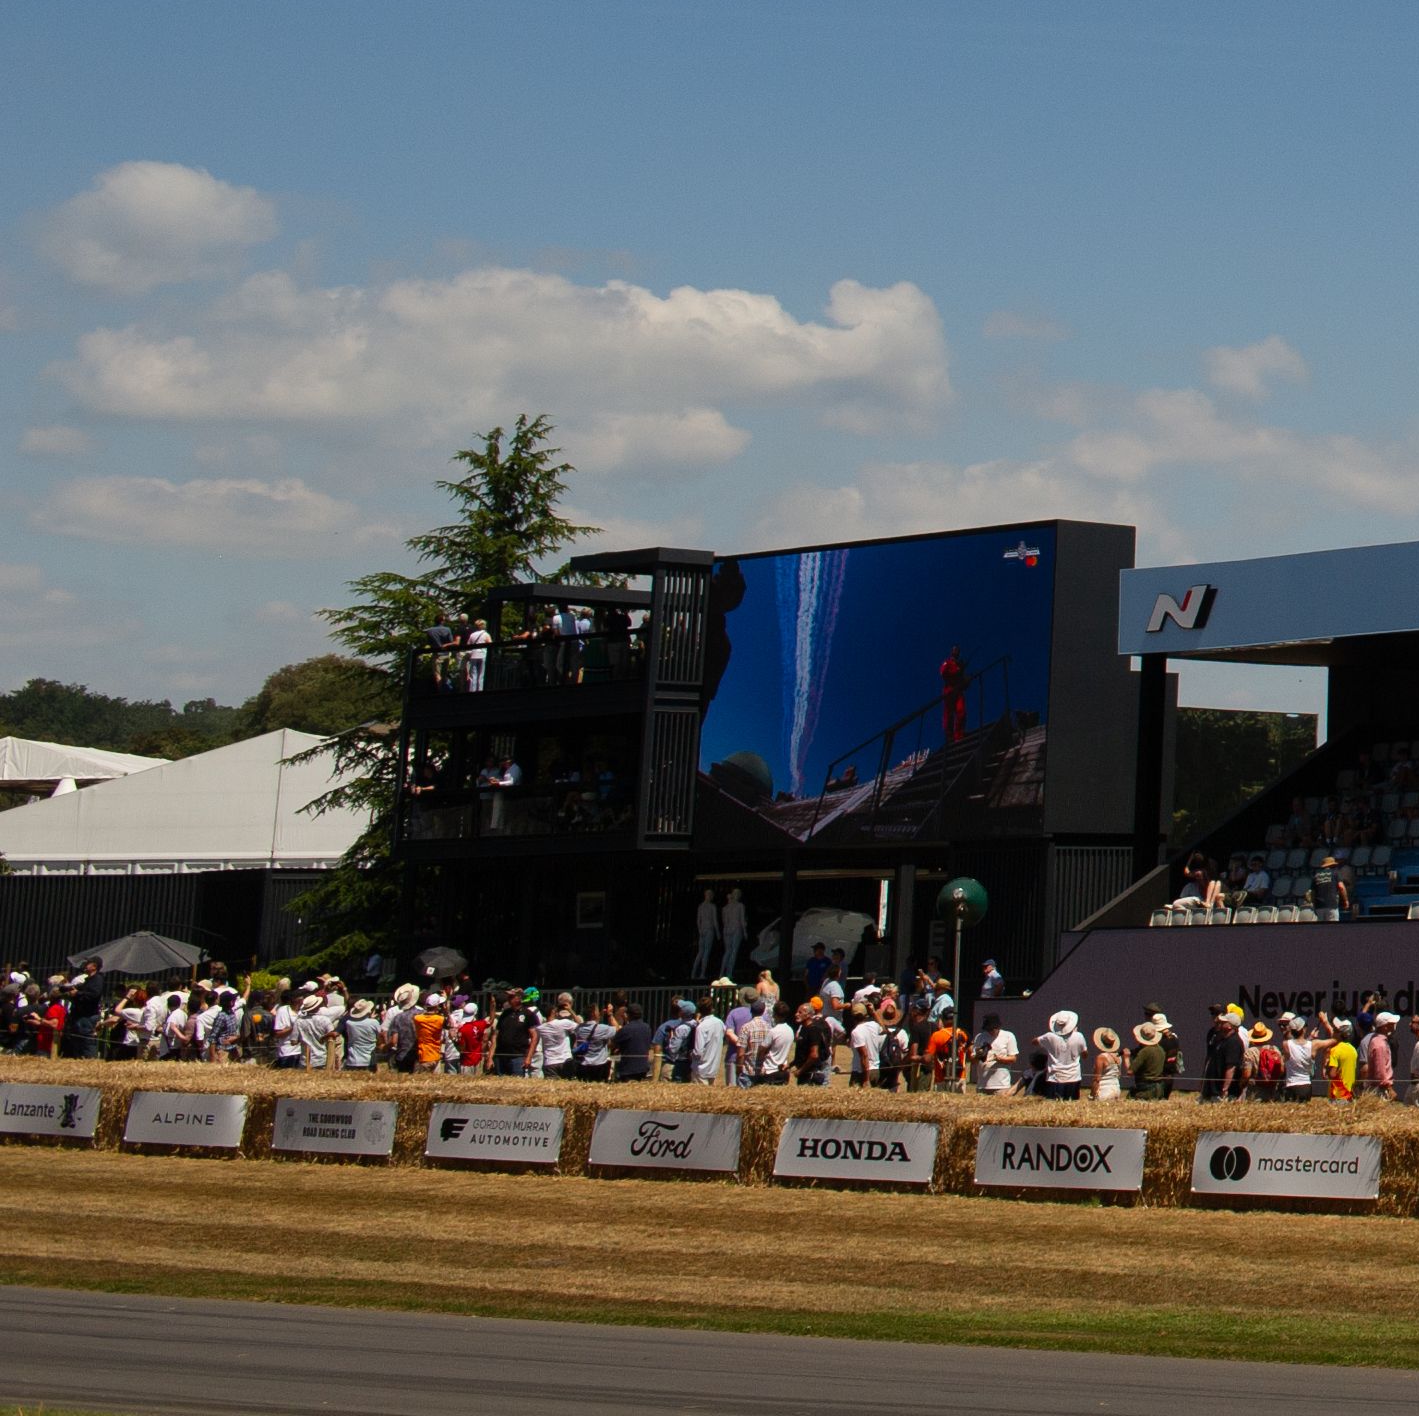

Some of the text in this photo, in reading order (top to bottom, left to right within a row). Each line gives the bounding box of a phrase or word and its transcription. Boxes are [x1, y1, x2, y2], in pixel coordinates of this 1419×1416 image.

[1145, 583, 1218, 633] N
[1238, 984, 1327, 1019] Never
[3, 1100, 55, 1118] Lanzante
[152, 1112, 215, 1126] ALPINE
[472, 1118, 551, 1132] GORDON MURRAY
[470, 1134, 549, 1147] AUTOMOTIVE
[631, 1120, 694, 1159] Ford
[796, 1138, 911, 1162] HONDA
[1002, 1142, 1114, 1173] RANDOX
[1257, 1156, 1359, 1174] mastercard
